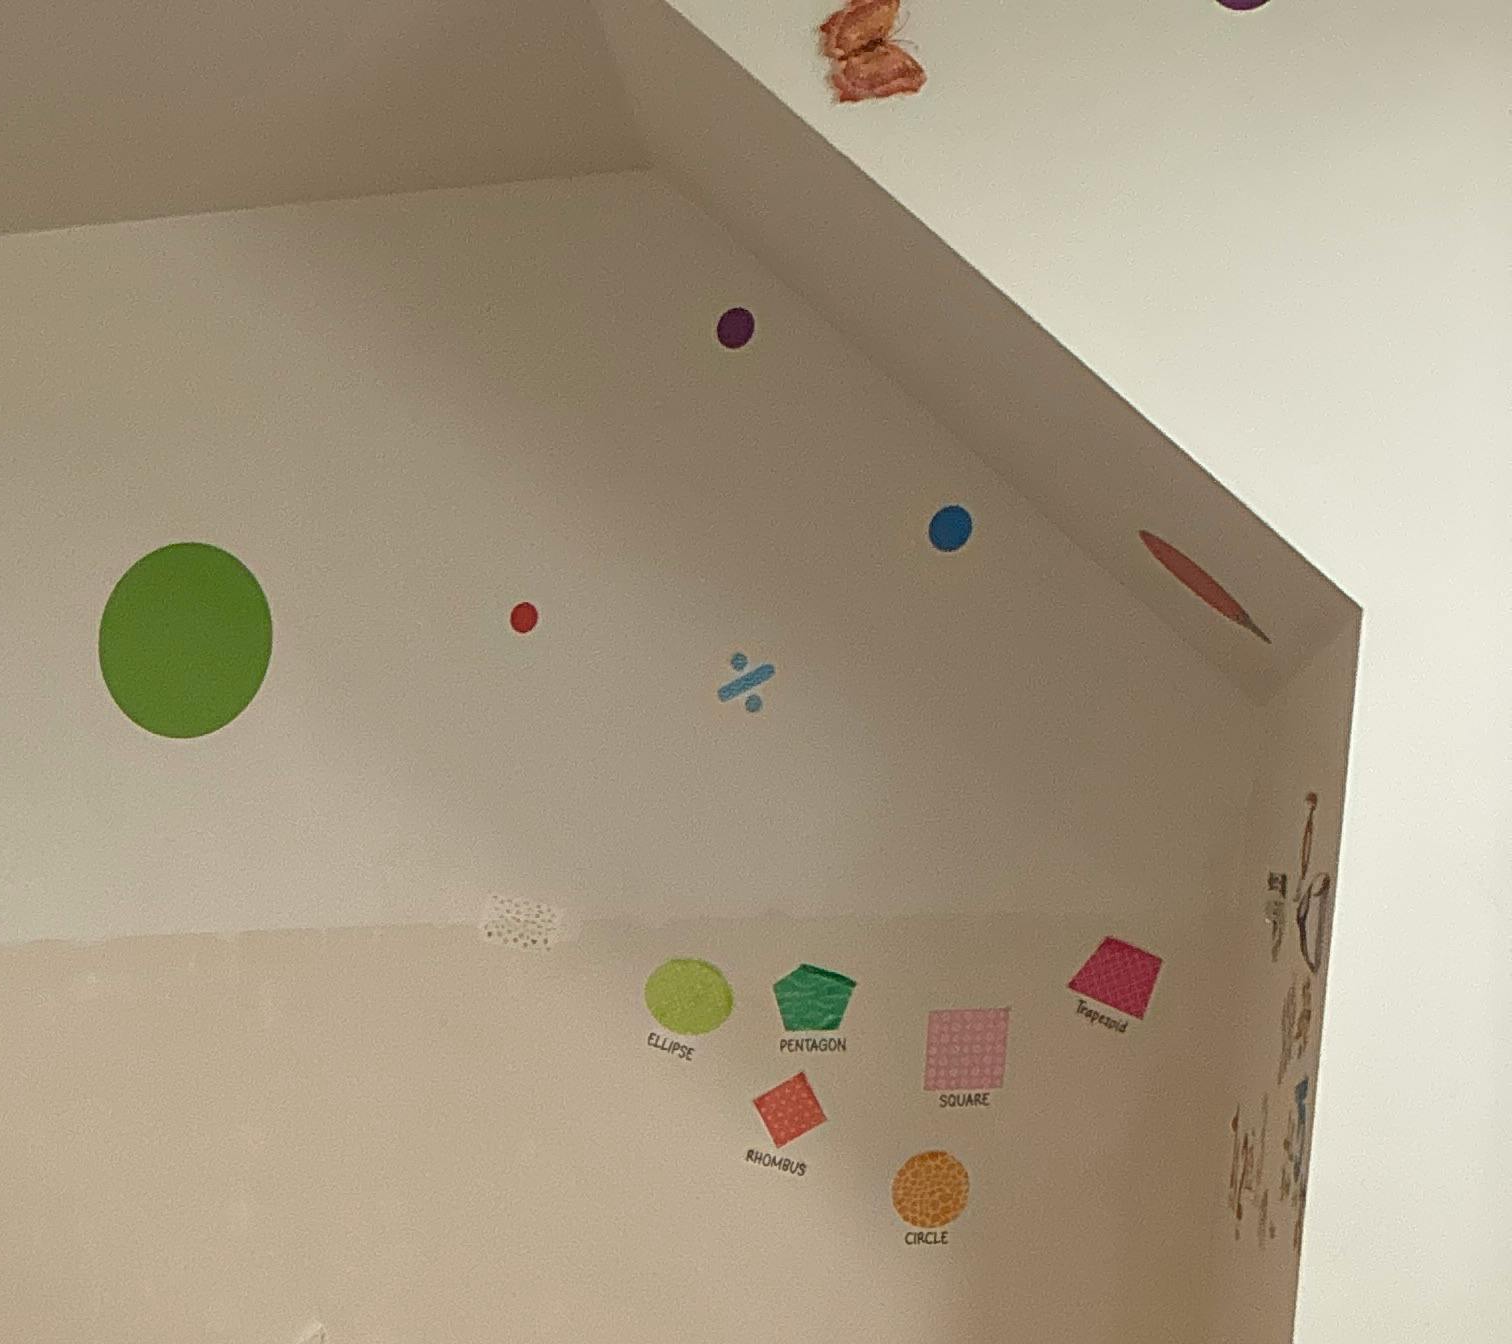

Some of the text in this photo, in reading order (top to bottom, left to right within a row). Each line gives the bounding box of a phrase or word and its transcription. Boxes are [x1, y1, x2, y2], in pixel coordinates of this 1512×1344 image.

[647, 1032, 695, 1061] ELLIPSE
[779, 1036, 847, 1053] PENTAGON
[939, 1091, 990, 1108] SQUARE
[745, 1148, 807, 1177] RHOMBUS
[904, 1231, 949, 1246] CIRCLE
